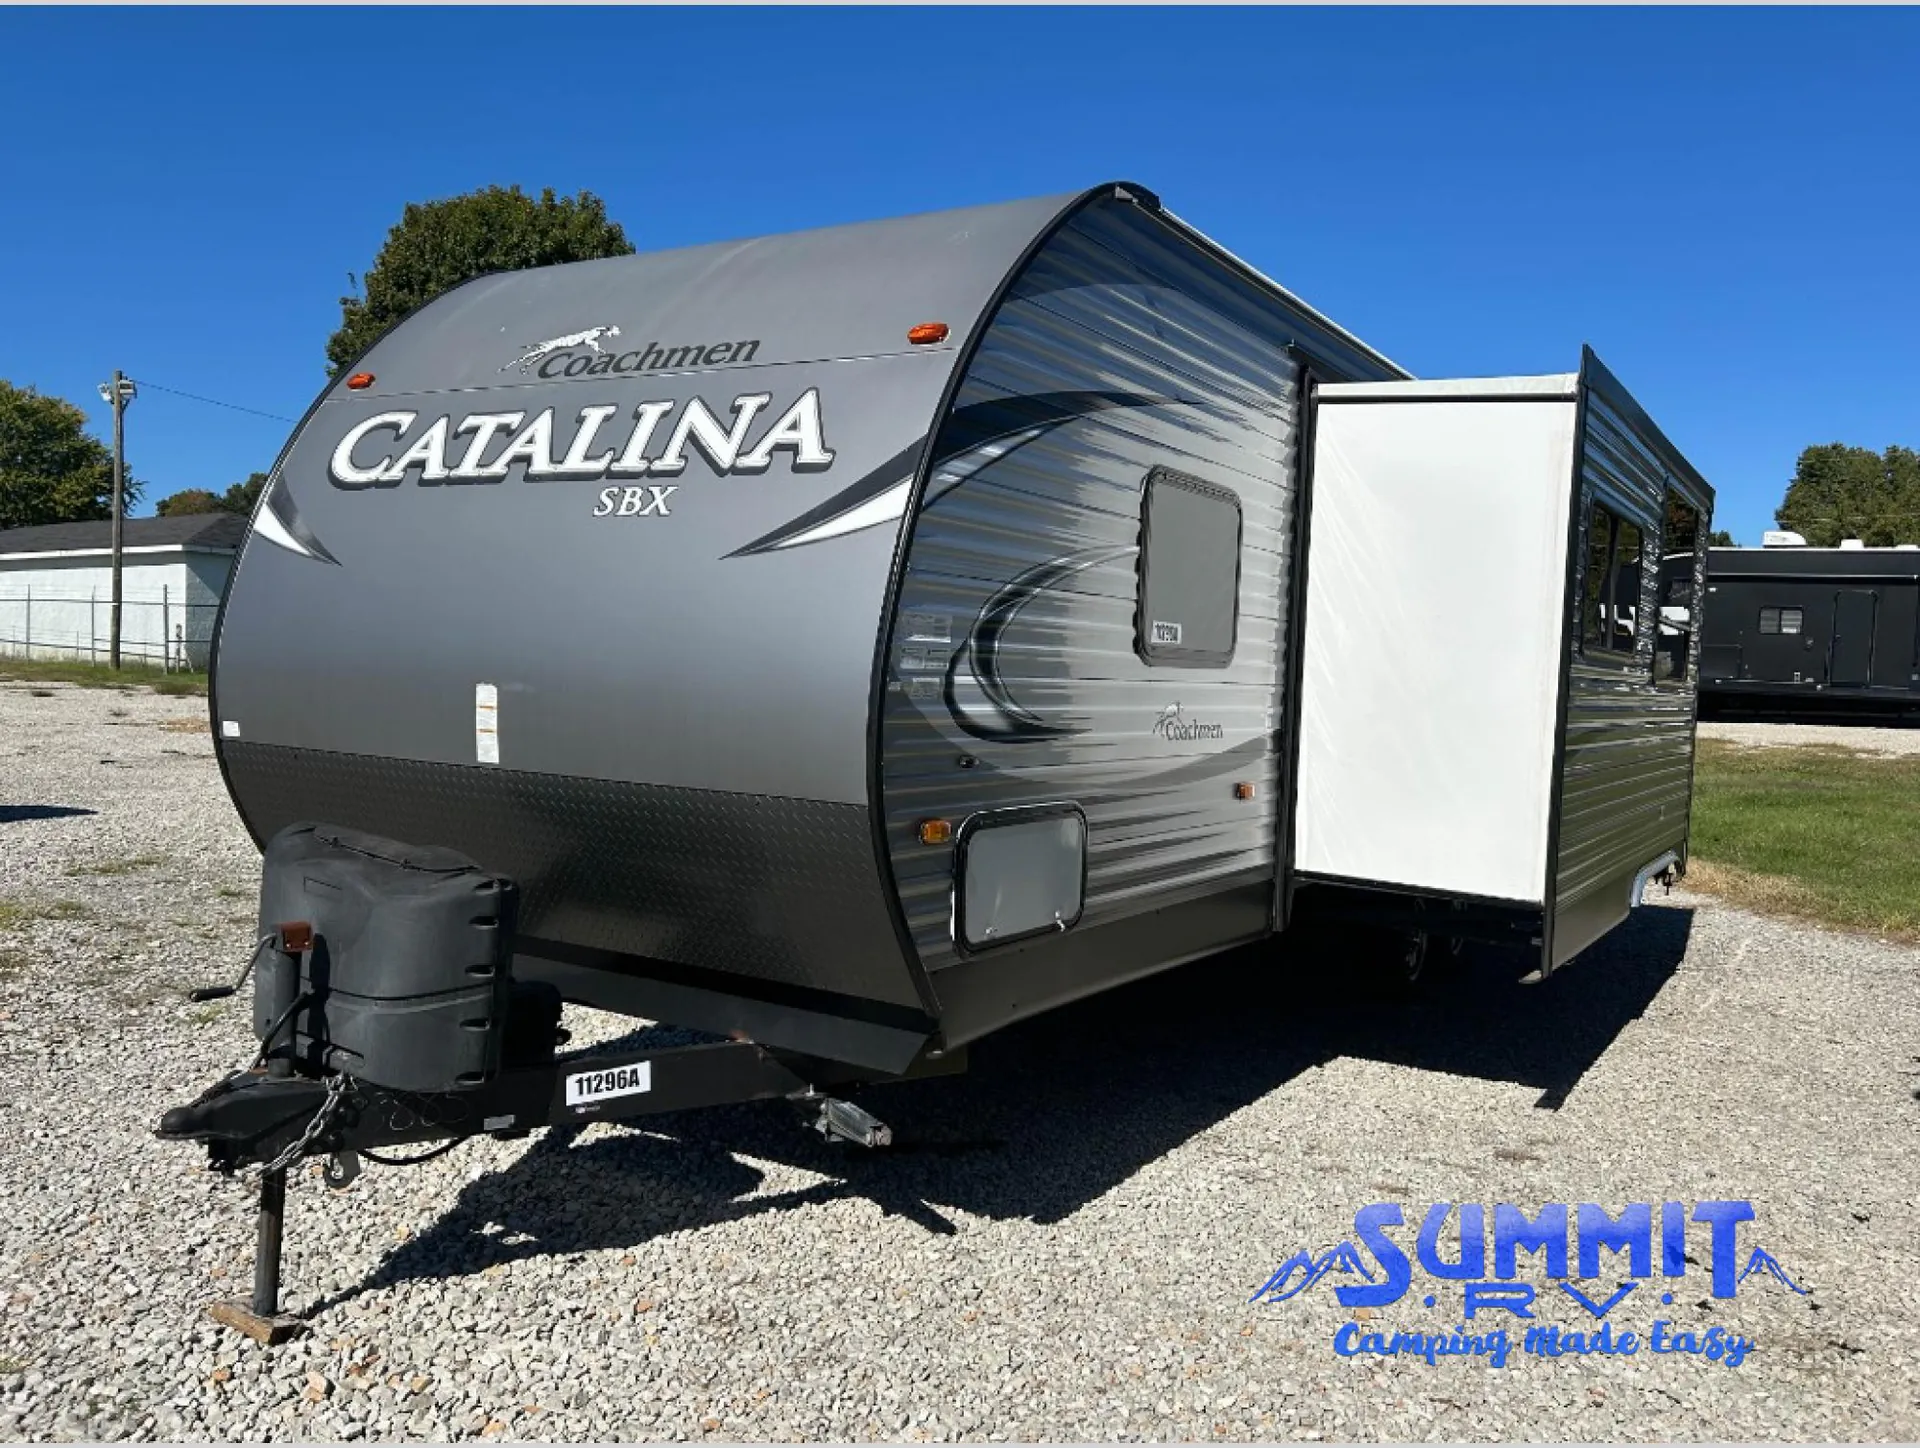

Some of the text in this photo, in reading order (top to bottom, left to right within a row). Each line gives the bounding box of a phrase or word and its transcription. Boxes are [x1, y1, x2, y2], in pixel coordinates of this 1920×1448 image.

[538, 340, 760, 379] Coachmen
[328, 386, 836, 490] CATALINA
[593, 485, 678, 517] SBX
[1166, 718, 1223, 741] Coachmen
[575, 1067, 640, 1096] 11296A
